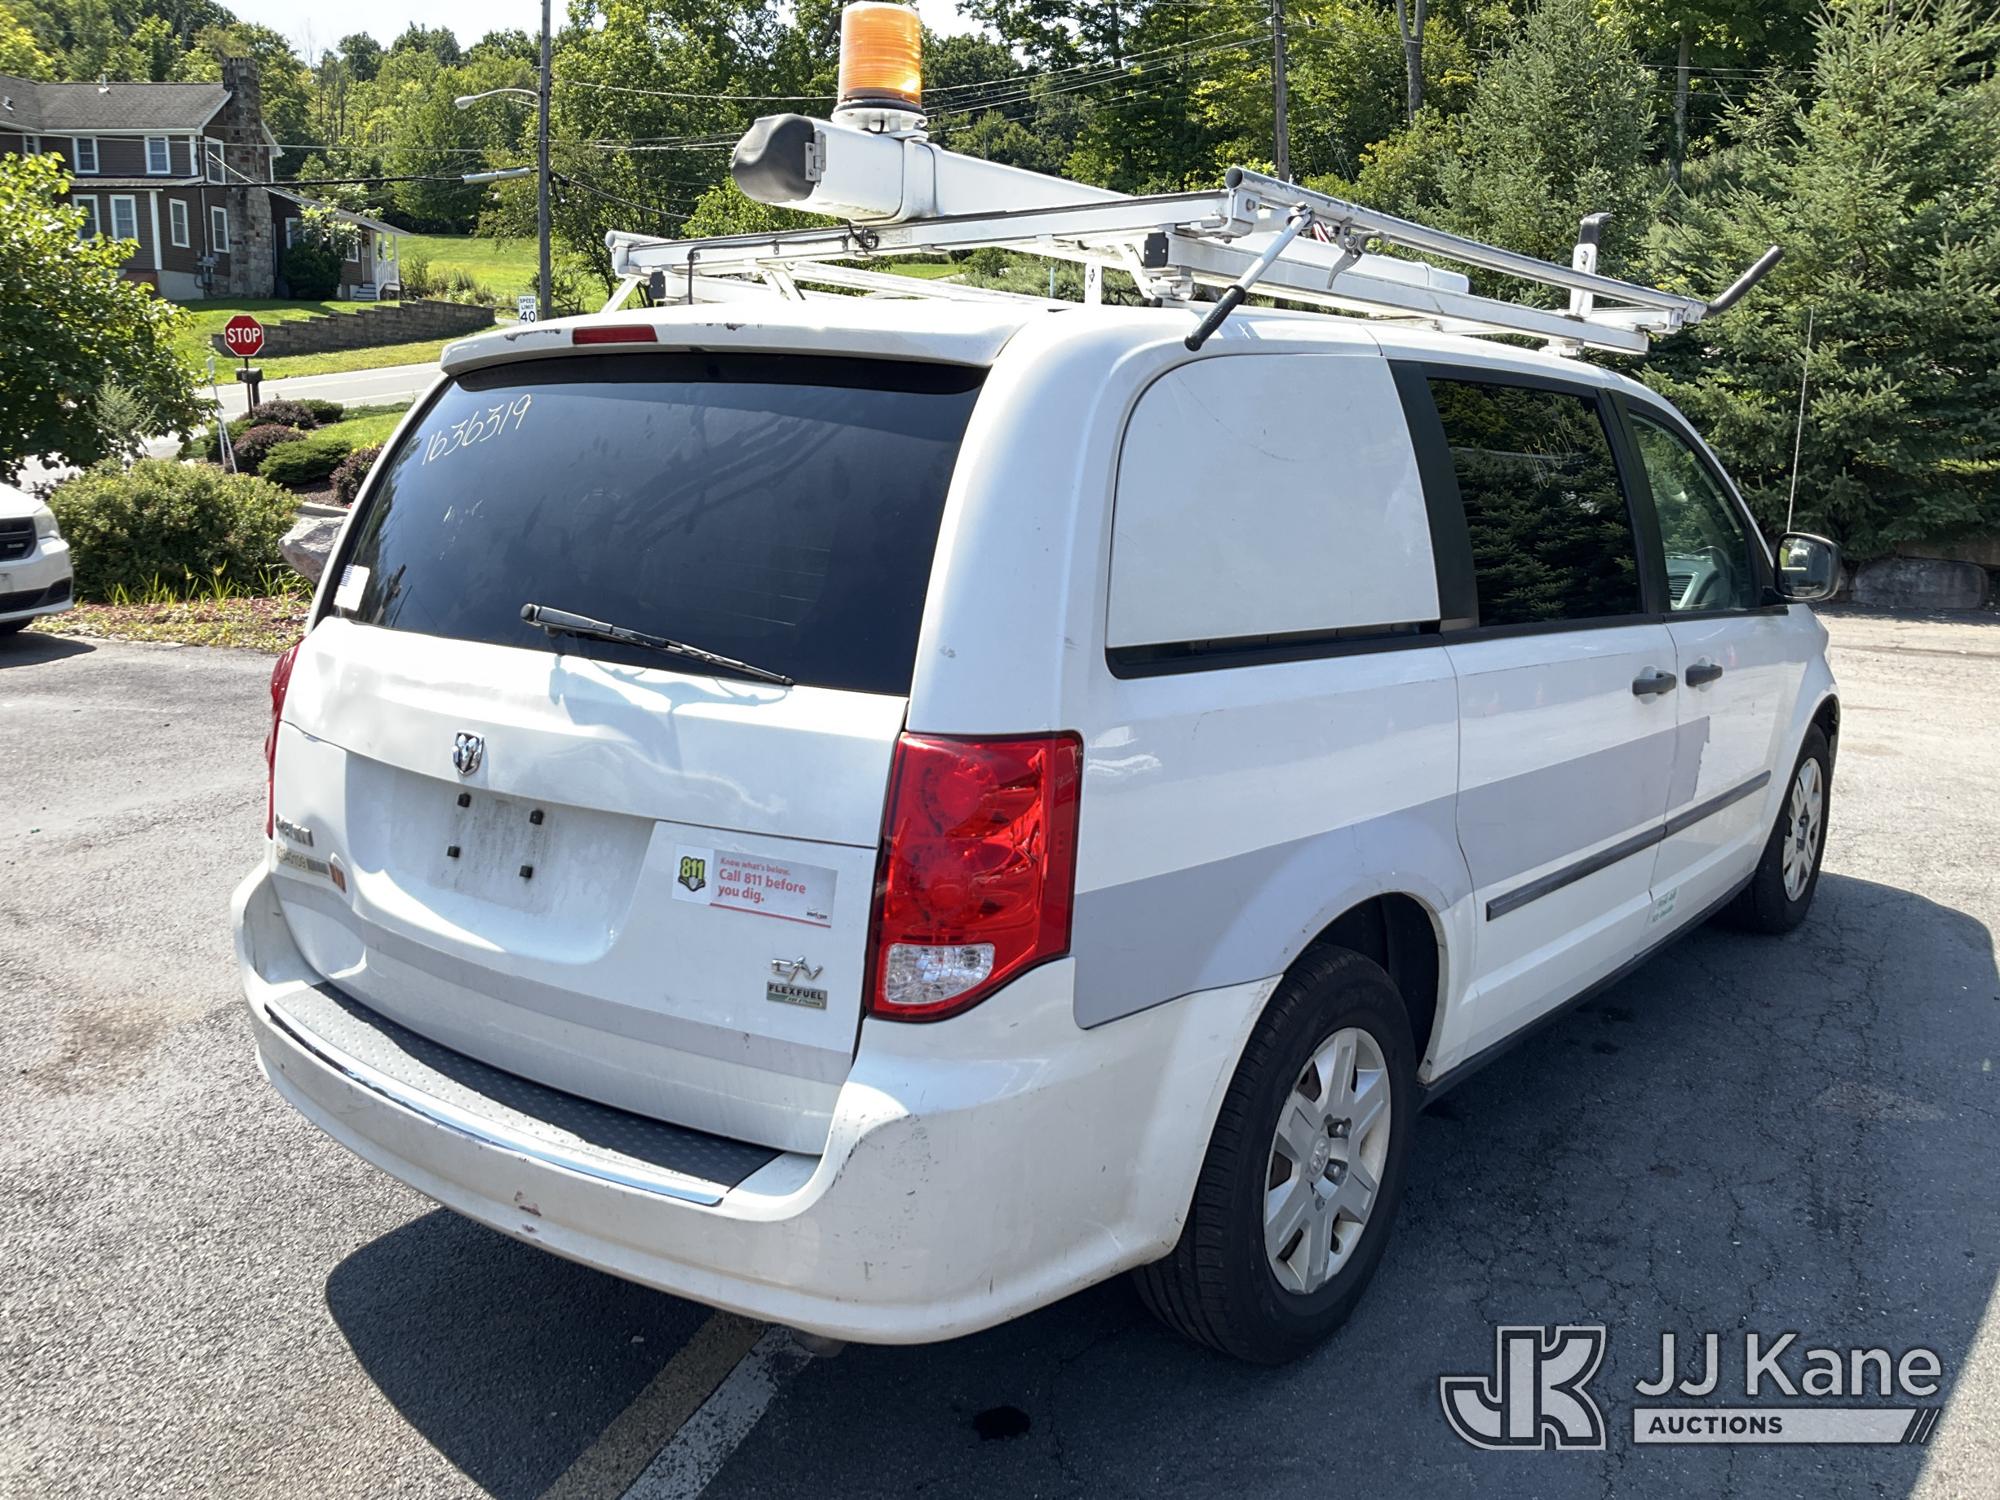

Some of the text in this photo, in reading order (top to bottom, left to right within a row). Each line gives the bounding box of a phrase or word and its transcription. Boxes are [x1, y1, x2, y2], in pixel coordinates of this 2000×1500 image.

[520, 311, 536, 323] 40
[227, 327, 261, 343] STOP
[421, 393, 532, 466] 1636319
[680, 855, 706, 880] 811
[720, 858, 791, 876] Know what's below.
[719, 868, 807, 894] Call 811 before
[718, 885, 765, 904] you dig.
[767, 983, 824, 1000] FLEXFUEL
